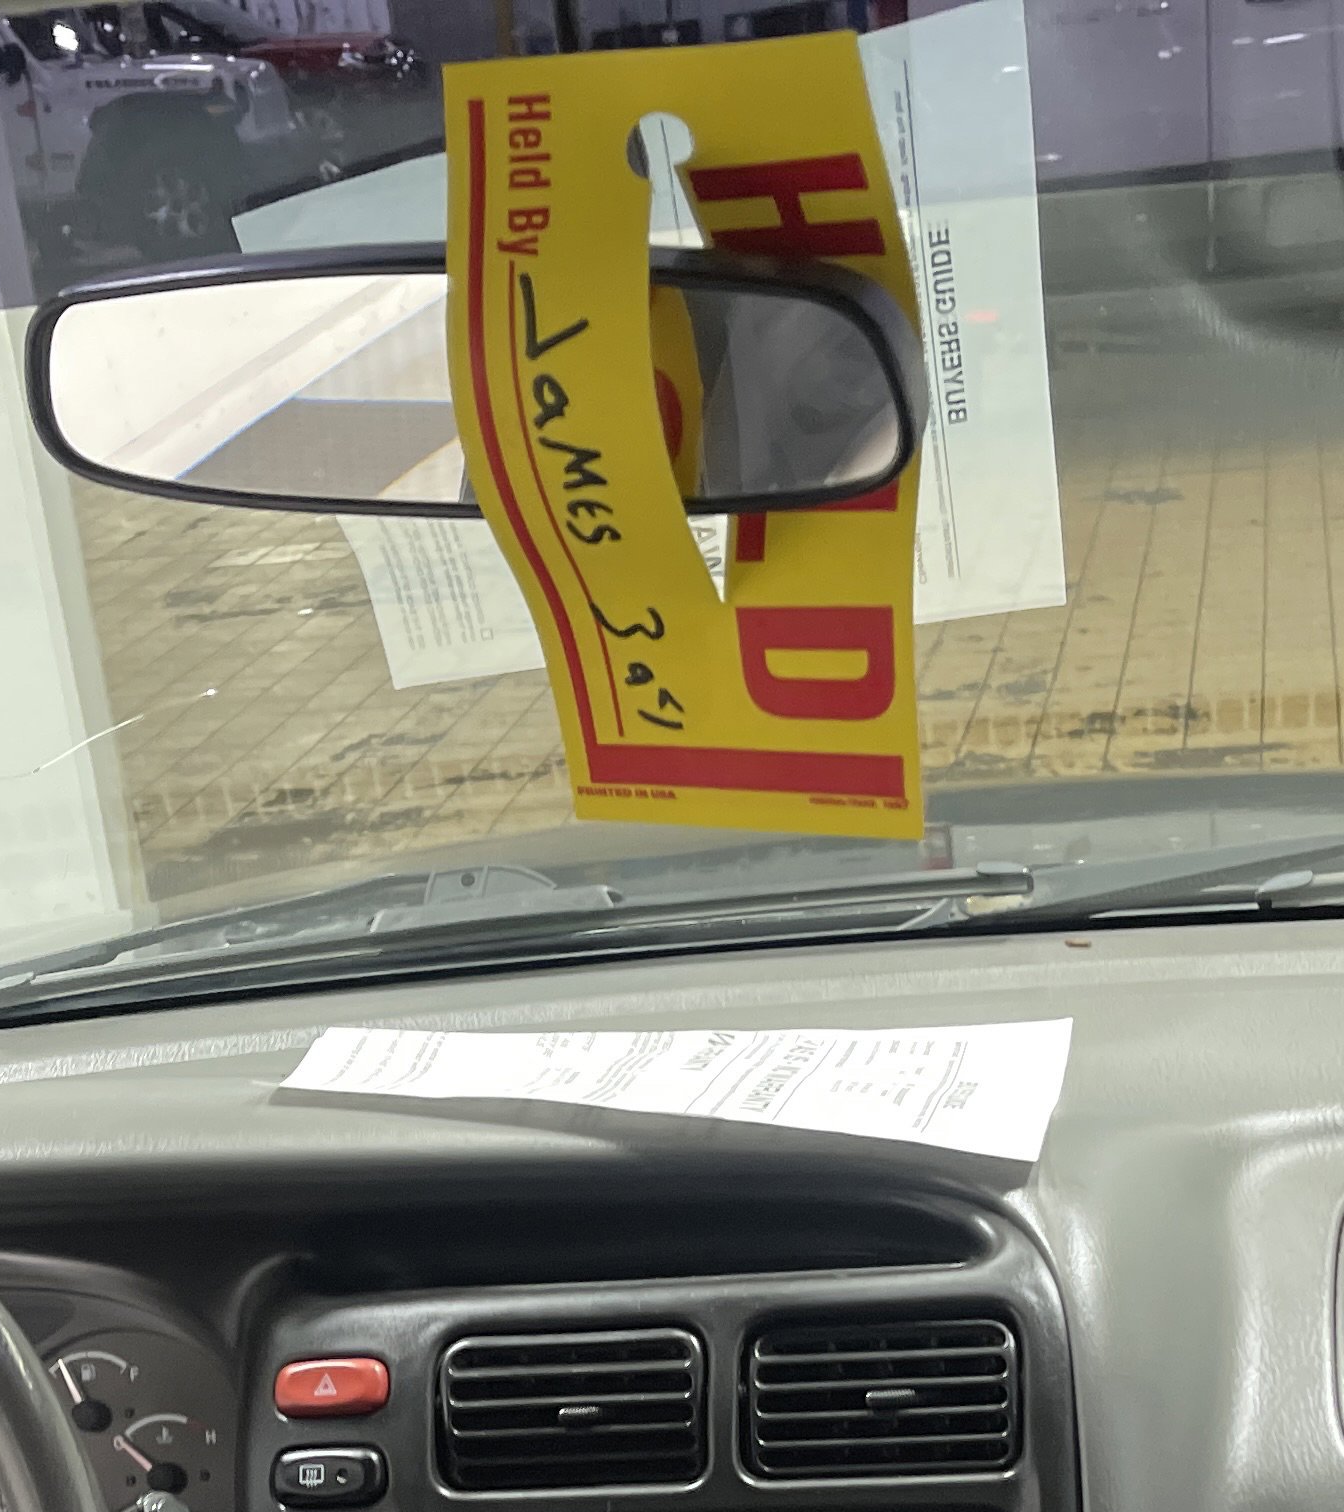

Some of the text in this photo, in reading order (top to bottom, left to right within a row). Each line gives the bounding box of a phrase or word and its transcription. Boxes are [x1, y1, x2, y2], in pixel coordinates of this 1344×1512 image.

[497, 91, 552, 257] Held By
[688, 152, 899, 722] HD
[129, 1365, 140, 1383] F
[205, 1429, 218, 1445] H
